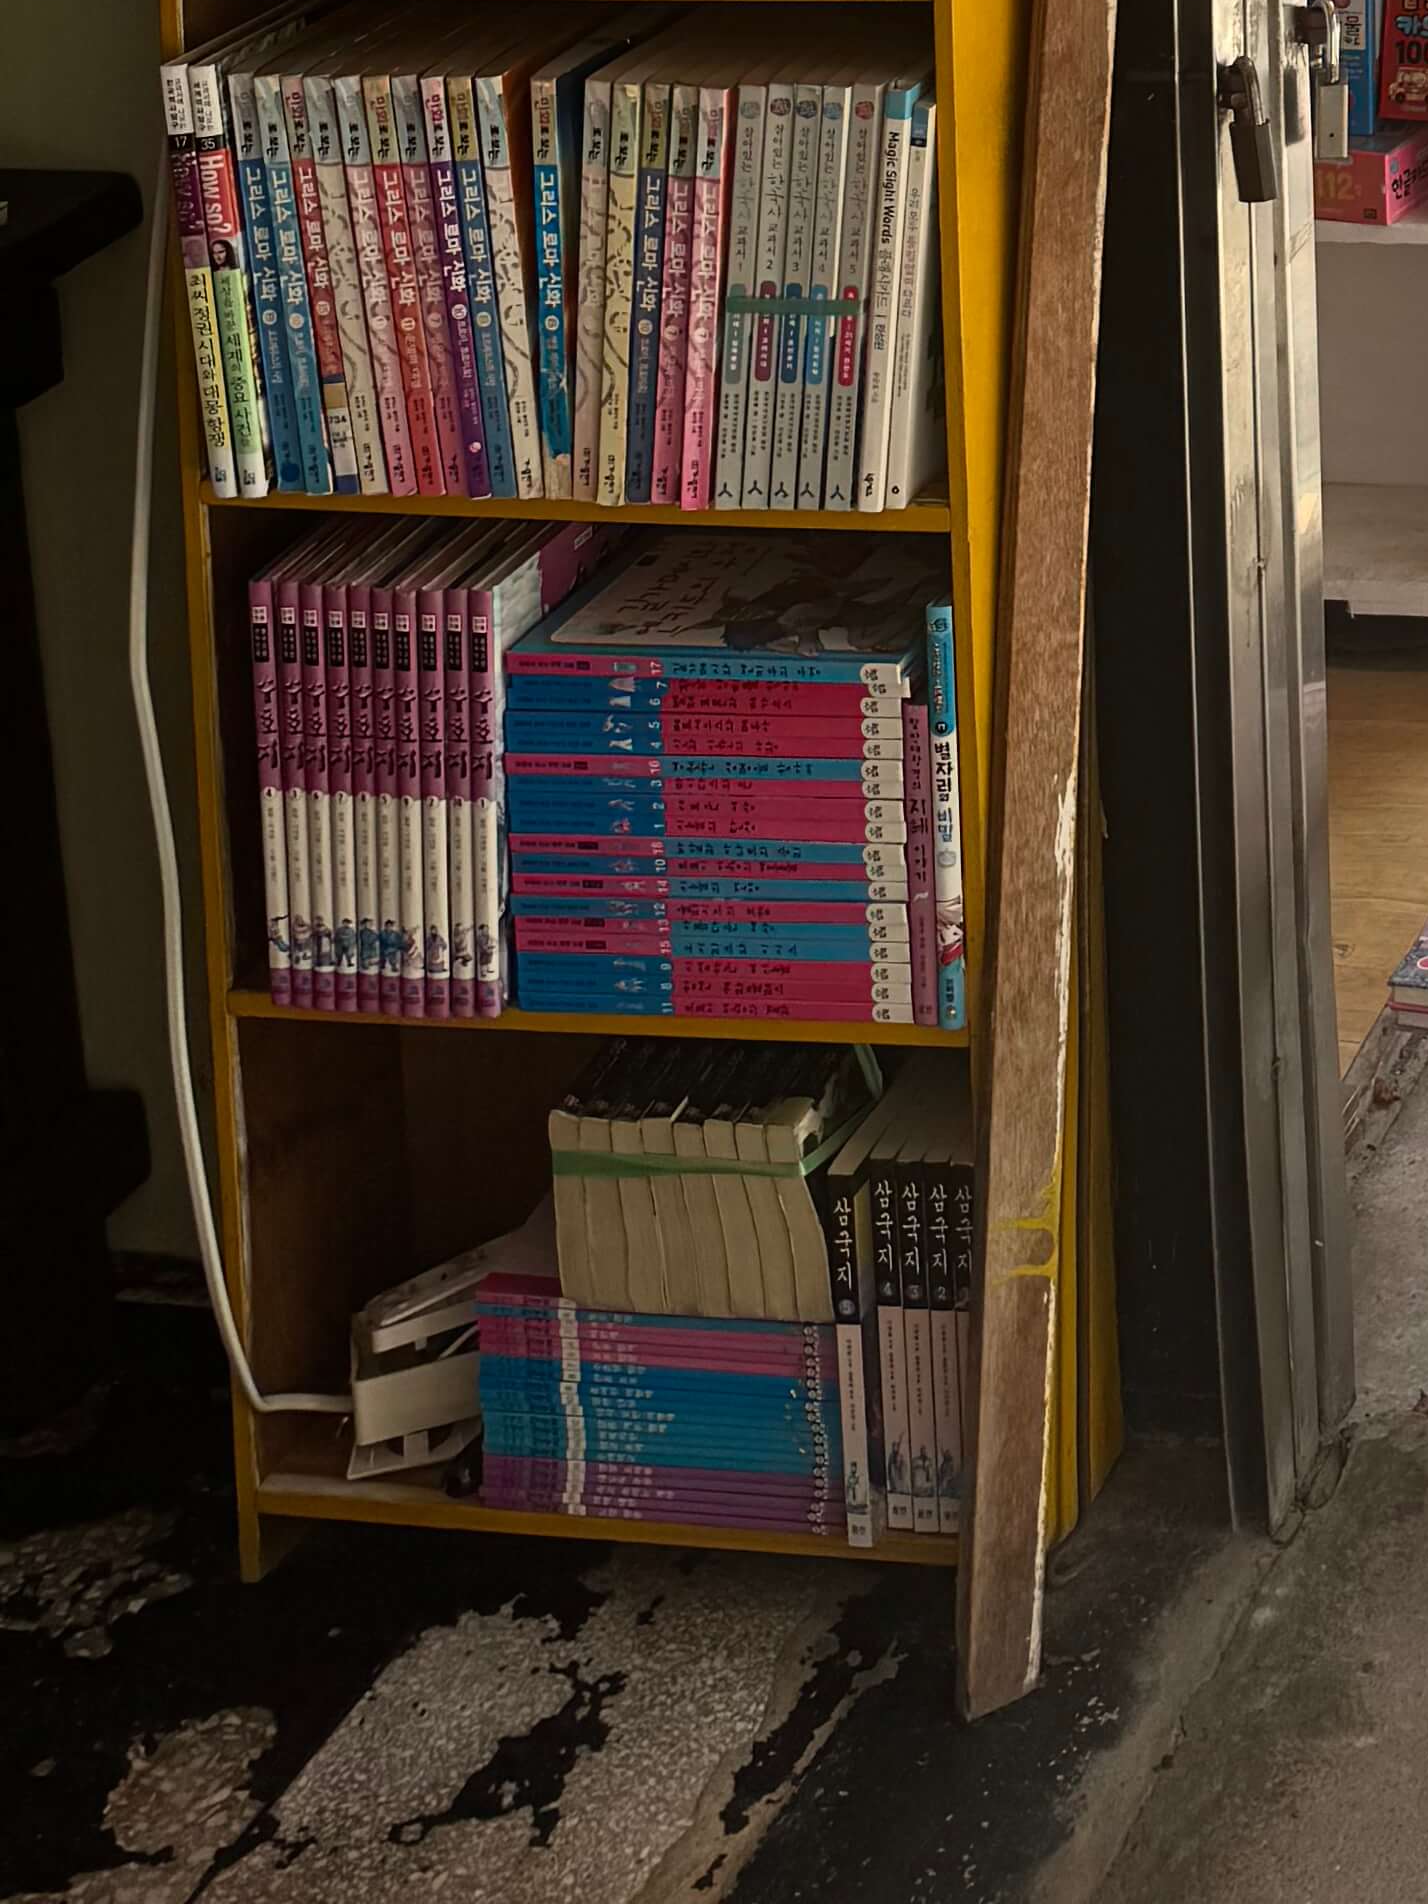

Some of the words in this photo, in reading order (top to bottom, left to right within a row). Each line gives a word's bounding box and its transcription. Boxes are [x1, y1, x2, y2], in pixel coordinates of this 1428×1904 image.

[886, 130, 901, 168] Magic
[199, 153, 225, 198] How
[882, 169, 899, 203] Sight
[539, 170, 557, 224] 그리스
[206, 201, 231, 234] so?
[881, 205, 896, 245] Words
[542, 230, 560, 267] 로마
[538, 271, 563, 307] 신화
[832, 1197, 853, 1292] 삼국지
[873, 1179, 894, 1274] 삼국지
